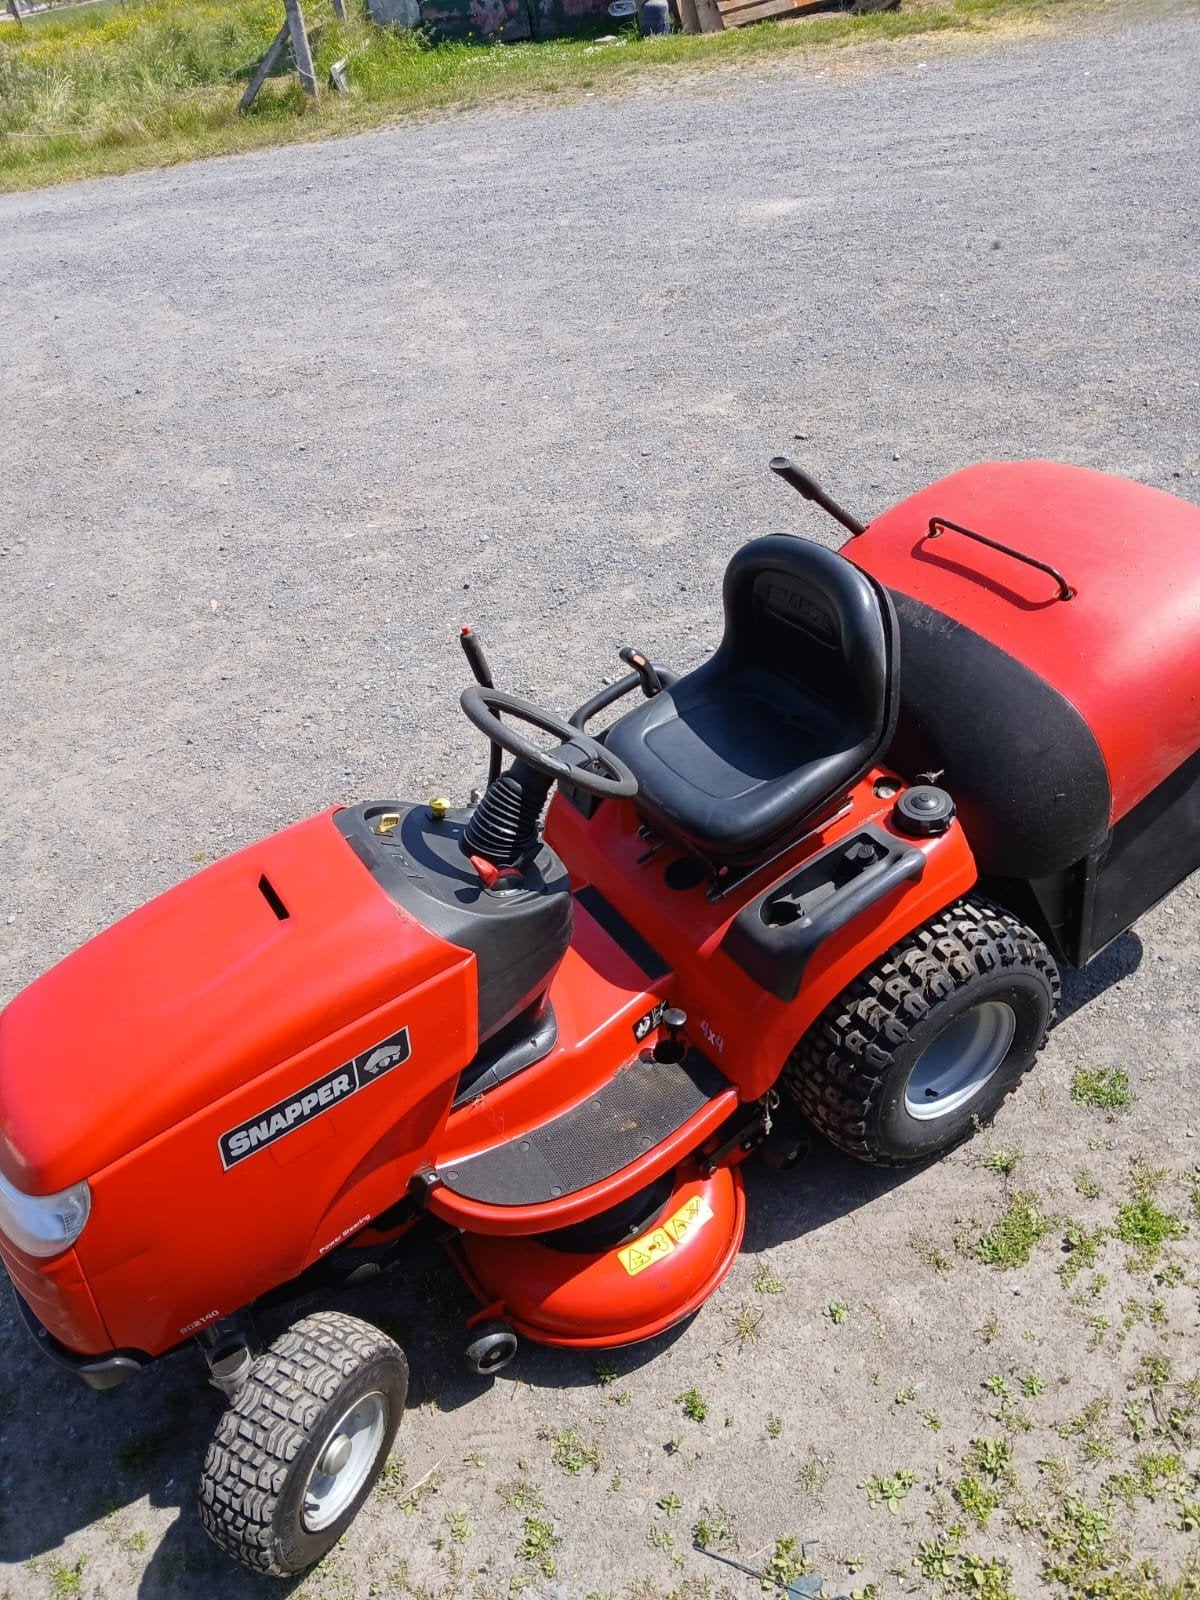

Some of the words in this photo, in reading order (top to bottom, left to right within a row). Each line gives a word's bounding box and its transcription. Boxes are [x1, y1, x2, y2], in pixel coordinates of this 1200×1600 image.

[700, 1020, 724, 1053] 4x4
[228, 1073, 352, 1157] SNAPPER
[319, 1235, 342, 1254] Power
